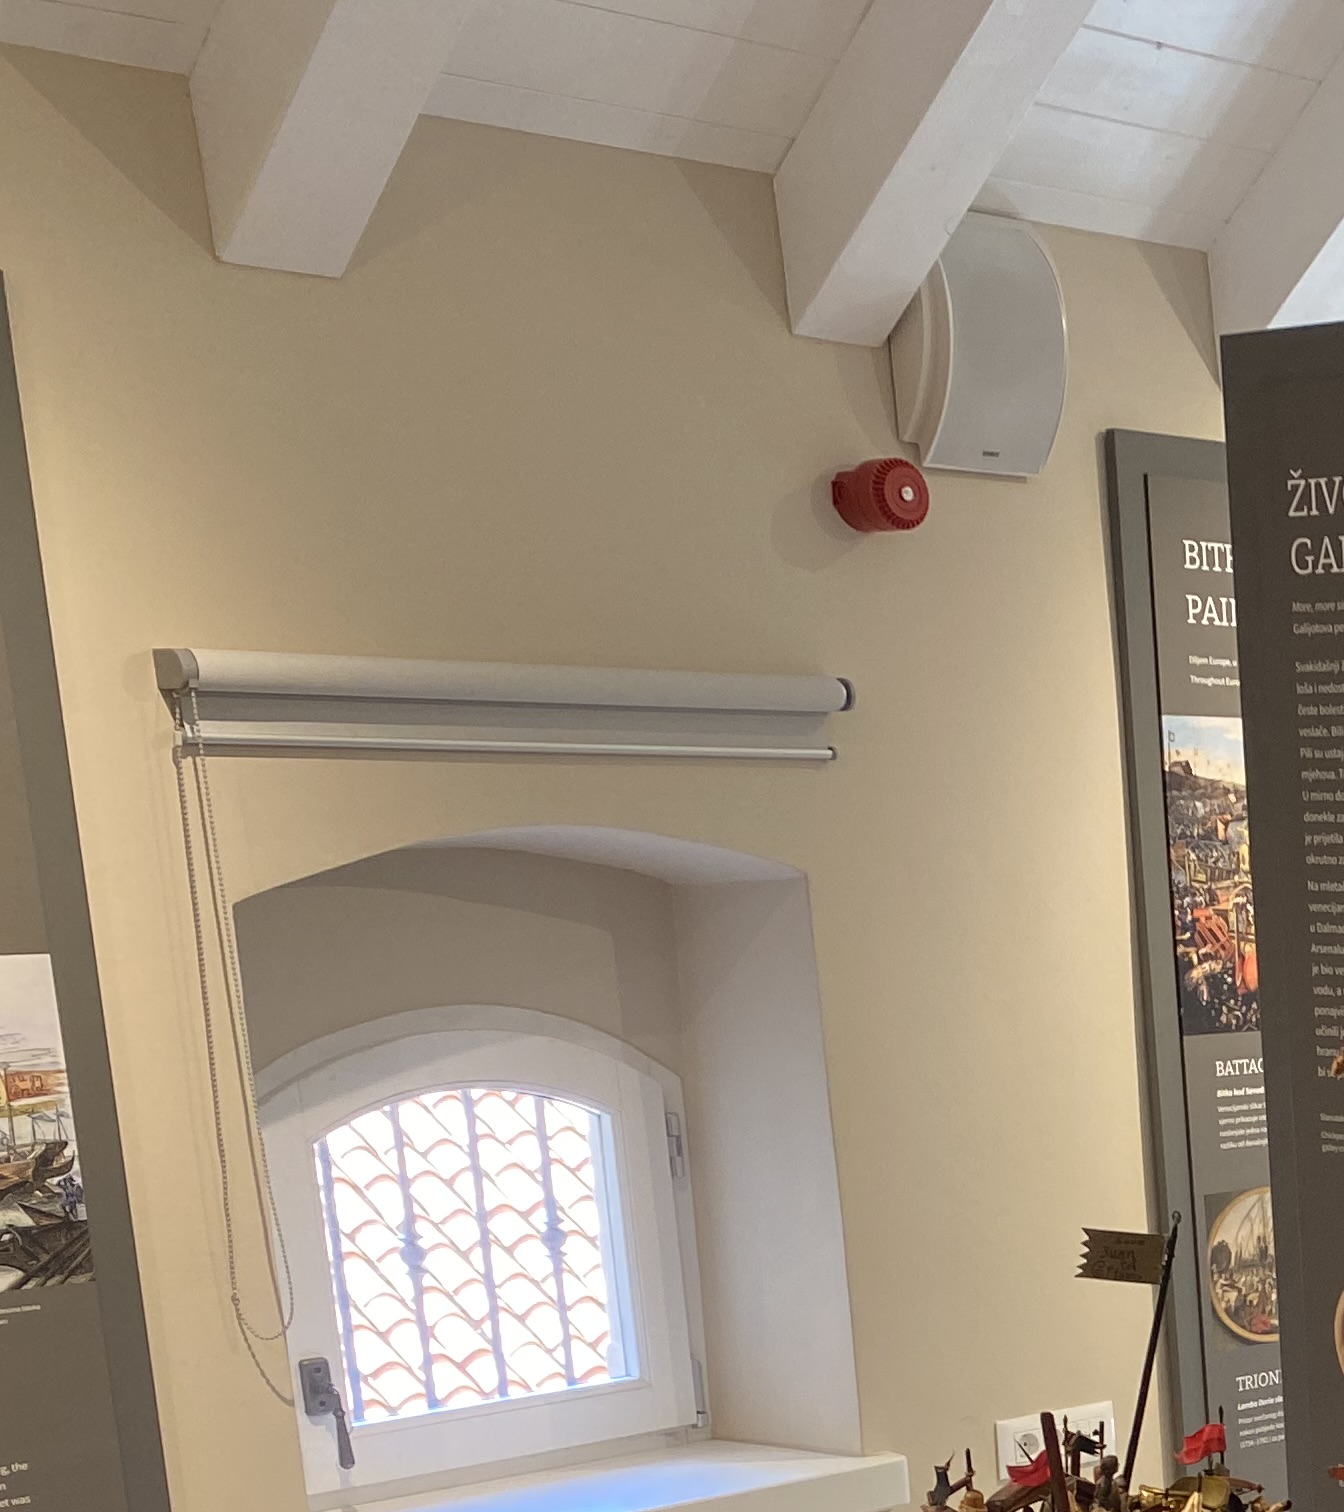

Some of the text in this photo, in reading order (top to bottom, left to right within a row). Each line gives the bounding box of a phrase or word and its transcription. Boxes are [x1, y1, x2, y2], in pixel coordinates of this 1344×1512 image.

[1236, 1369, 1281, 1391] TRION
[11, 1462, 28, 1472] the
[11, 1496, 31, 1505] was
